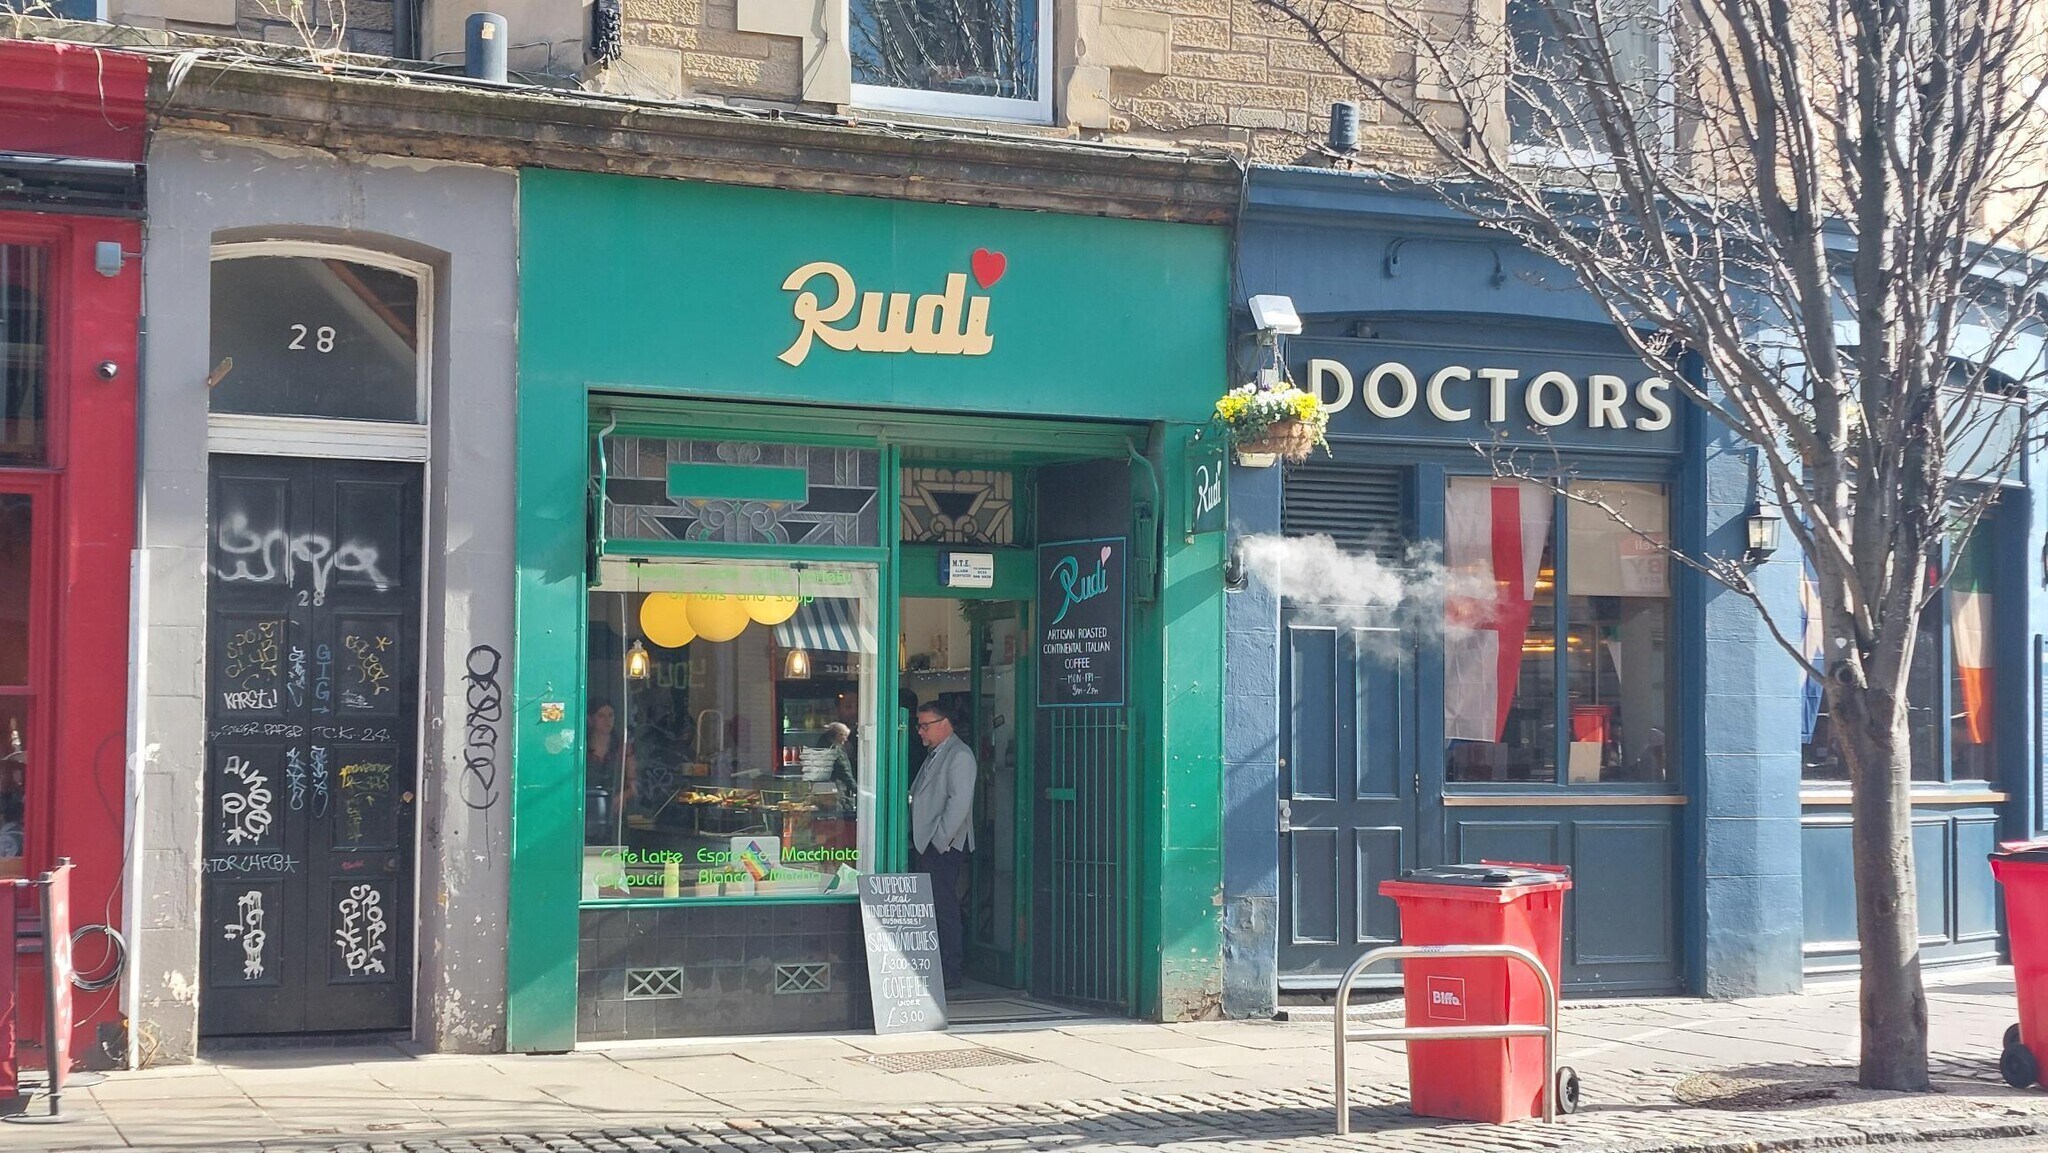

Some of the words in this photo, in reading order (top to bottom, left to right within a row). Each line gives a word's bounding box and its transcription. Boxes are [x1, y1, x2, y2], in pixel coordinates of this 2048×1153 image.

[777, 259, 994, 367] Rudi
[288, 323, 336, 353] 28
[1307, 358, 1673, 432] DOCTORS
[1196, 460, 1222, 520] Rudi
[298, 590, 325, 607] 28
[1050, 554, 1108, 625] Rudi
[776, 592, 814, 606] soup
[1047, 629, 1076, 640] ARTISAN
[1078, 627, 1108, 639] ROASTED
[1043, 642, 1083, 655] CONTINENTAL
[1085, 641, 1111, 652] ITALIAN
[1064, 657, 1090, 669] COFFEE
[601, 848, 638, 864] Cafe
[641, 848, 683, 864] Latte
[696, 847, 768, 866] Espreo
[780, 845, 860, 861] Macchiato
[698, 869, 751, 885] Blanco
[869, 876, 918, 895] SUPPORT
[883, 893, 911, 903] local
[864, 903, 935, 918] INDEPENDENT
[881, 917, 922, 925] BUSINESSES!
[867, 930, 938, 953] SANDWICHES
[882, 975, 931, 999] COFFEE
